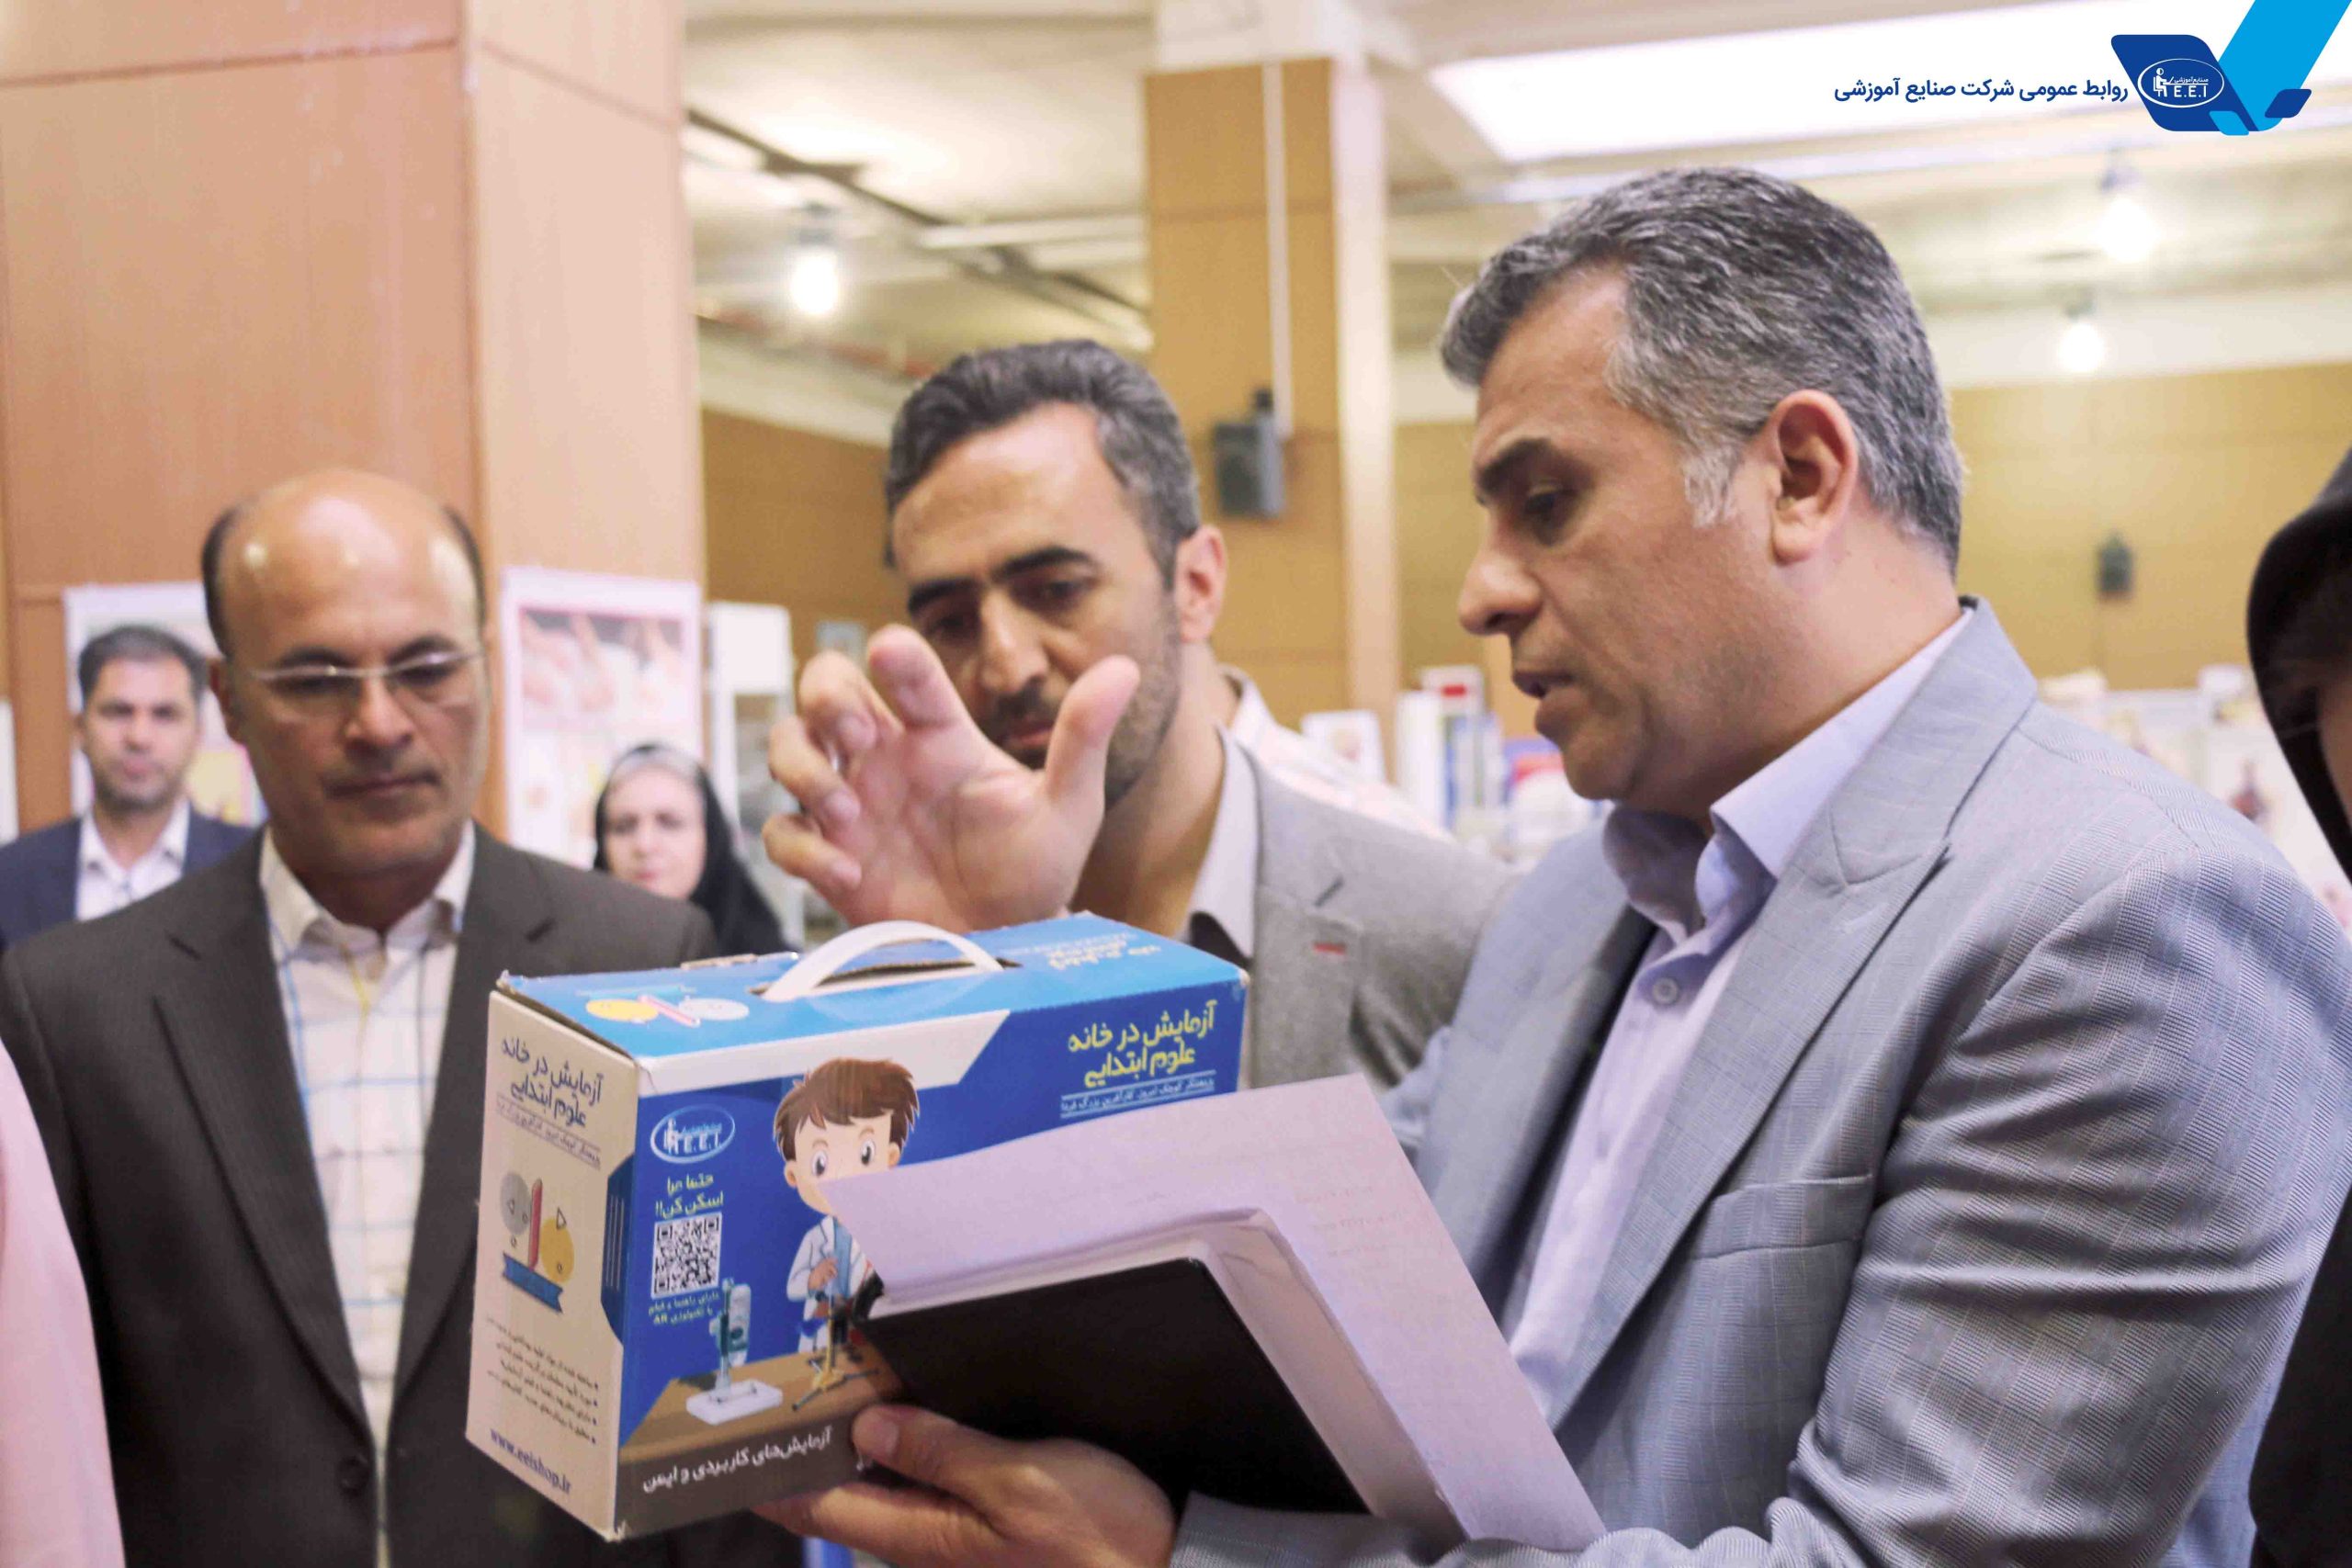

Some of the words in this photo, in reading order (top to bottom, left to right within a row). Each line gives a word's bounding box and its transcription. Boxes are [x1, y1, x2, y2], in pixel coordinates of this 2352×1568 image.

[1069, 1021, 1113, 1052] خانه
[1117, 1023, 1140, 1051] در
[1143, 999, 1217, 1046] آزمایش
[502, 1037, 530, 1063] خانه
[533, 1056, 548, 1076] در
[1085, 1047, 1148, 1088] ابتدایی
[1150, 1039, 1195, 1077] علوم
[511, 1074, 552, 1113] ابتدایی
[550, 1060, 604, 1106] آزمایش
[554, 1092, 586, 1127] علوم
[685, 1190, 724, 1216] اسکن
[490, 1427, 571, 1495] www.eeishop.ir
